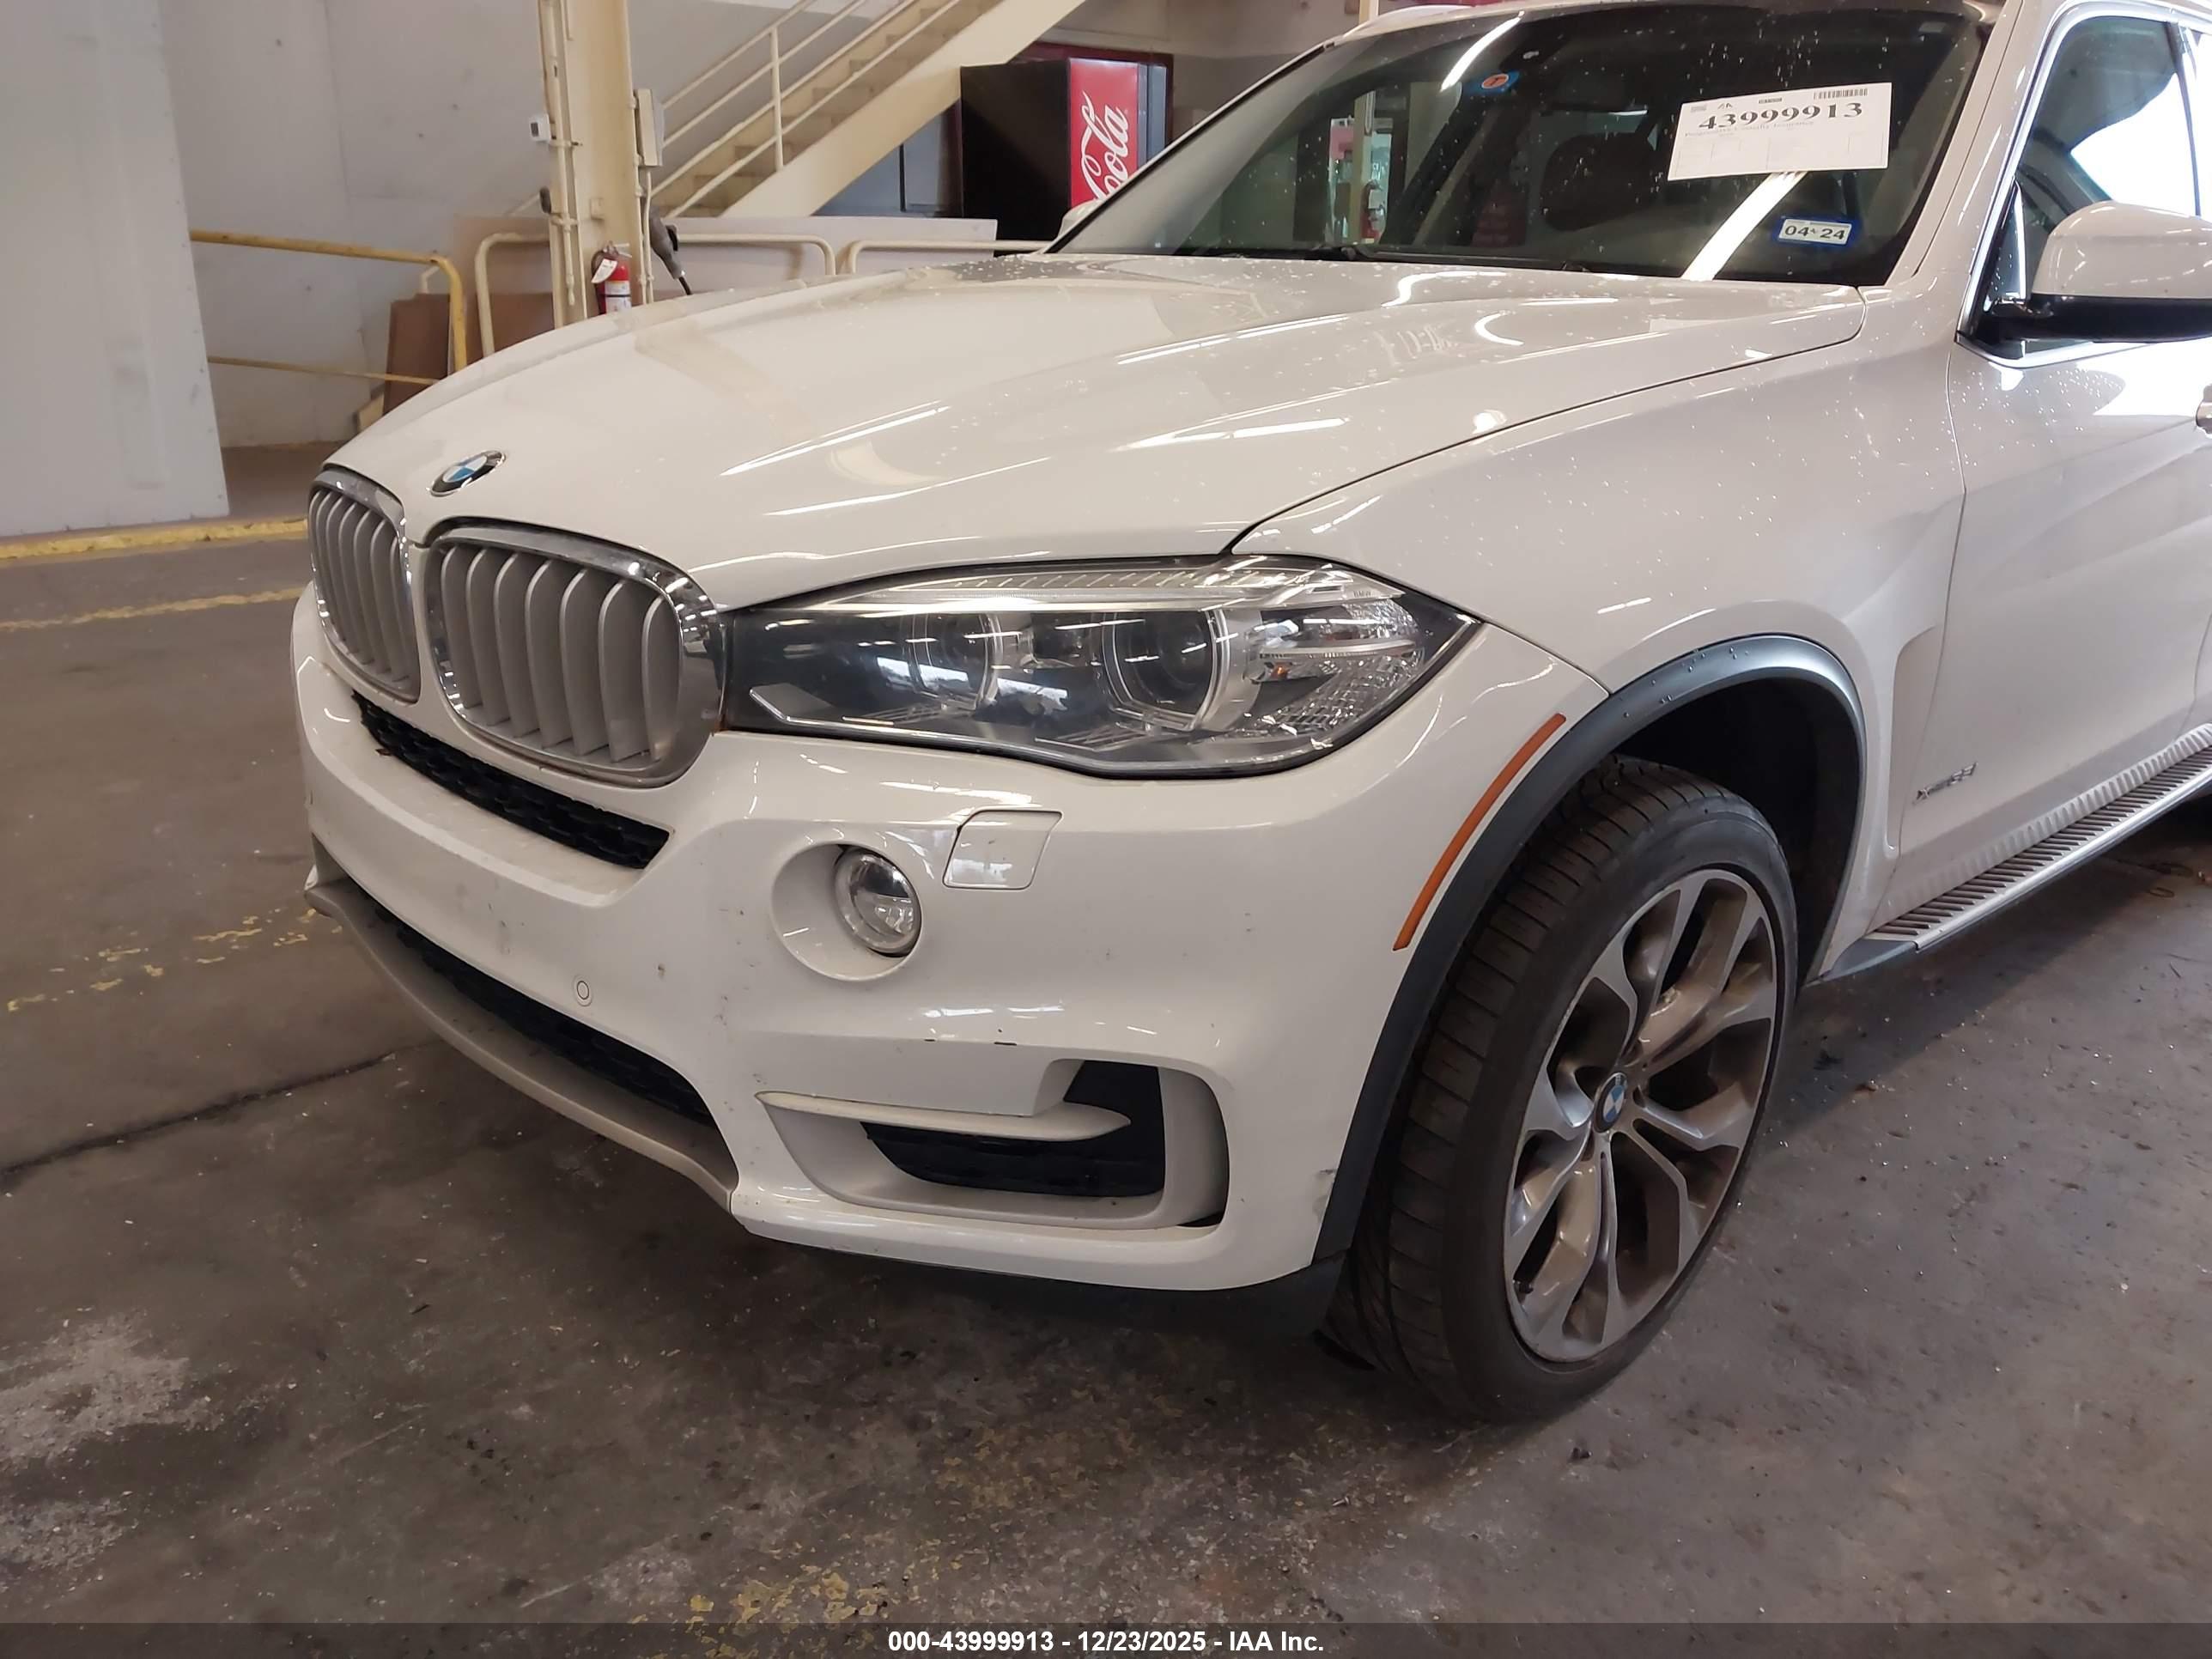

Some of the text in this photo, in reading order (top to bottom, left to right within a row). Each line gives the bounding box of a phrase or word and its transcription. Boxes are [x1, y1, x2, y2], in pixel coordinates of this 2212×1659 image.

[1698, 102, 1863, 130] 43999913
[1080, 89, 1129, 201] Cola
[1784, 225, 1845, 240] 04 24
